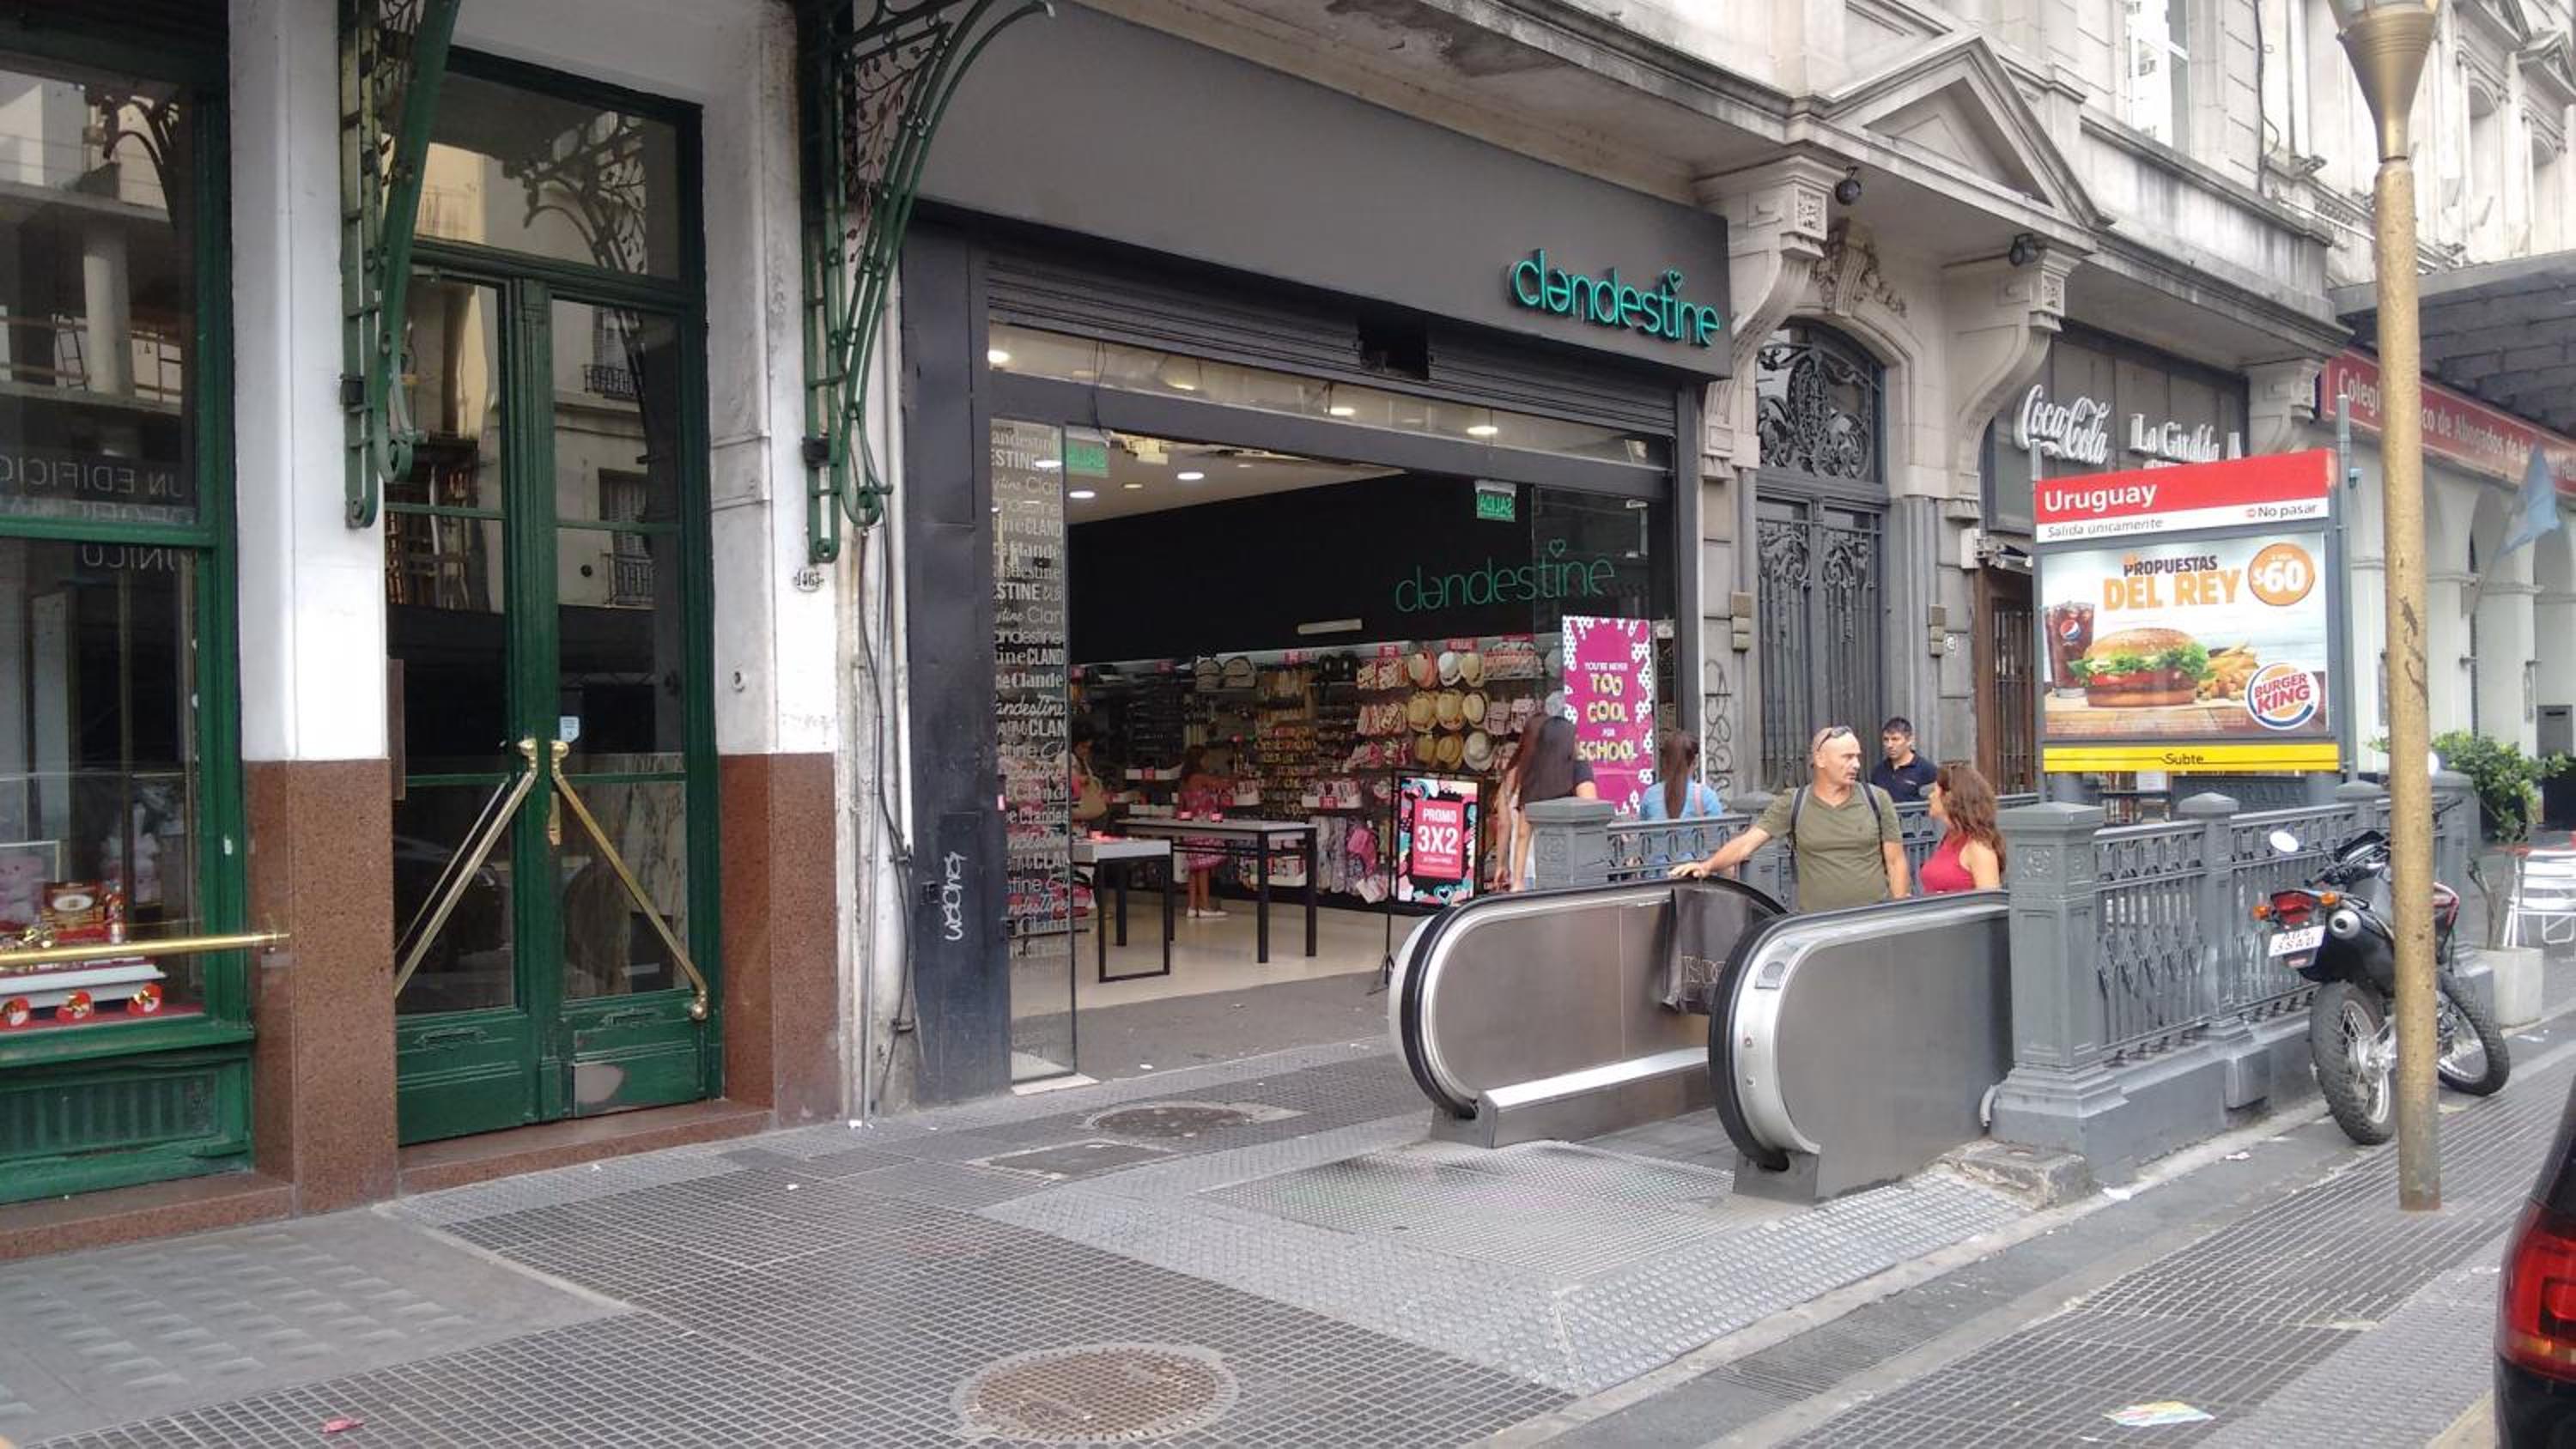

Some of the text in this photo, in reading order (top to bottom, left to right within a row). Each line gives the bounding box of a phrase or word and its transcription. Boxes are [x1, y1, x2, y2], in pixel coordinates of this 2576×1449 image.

[1512, 246, 1720, 347] clandestine
[2129, 413, 2220, 463] La Giralda
[2043, 483, 2158, 513] Uruguay
[2257, 503, 2318, 520] No pasar
[2047, 523, 2085, 538] Salida
[1394, 538, 1615, 613] clandestine
[2123, 555, 2218, 578] PROPUESTAS
[2252, 560, 2308, 594] $60
[2104, 568, 2243, 612] DEL REY
[1590, 672, 1624, 697] TOO
[2254, 672, 2308, 698] BURGER
[1586, 700, 1629, 723] COOL
[2256, 687, 2311, 717] KING
[1577, 739, 1638, 762] SCHOOL
[2164, 752, 2205, 766] Subte
[1422, 807, 1458, 824] PROMO
[1417, 825, 1459, 855] 3X2
